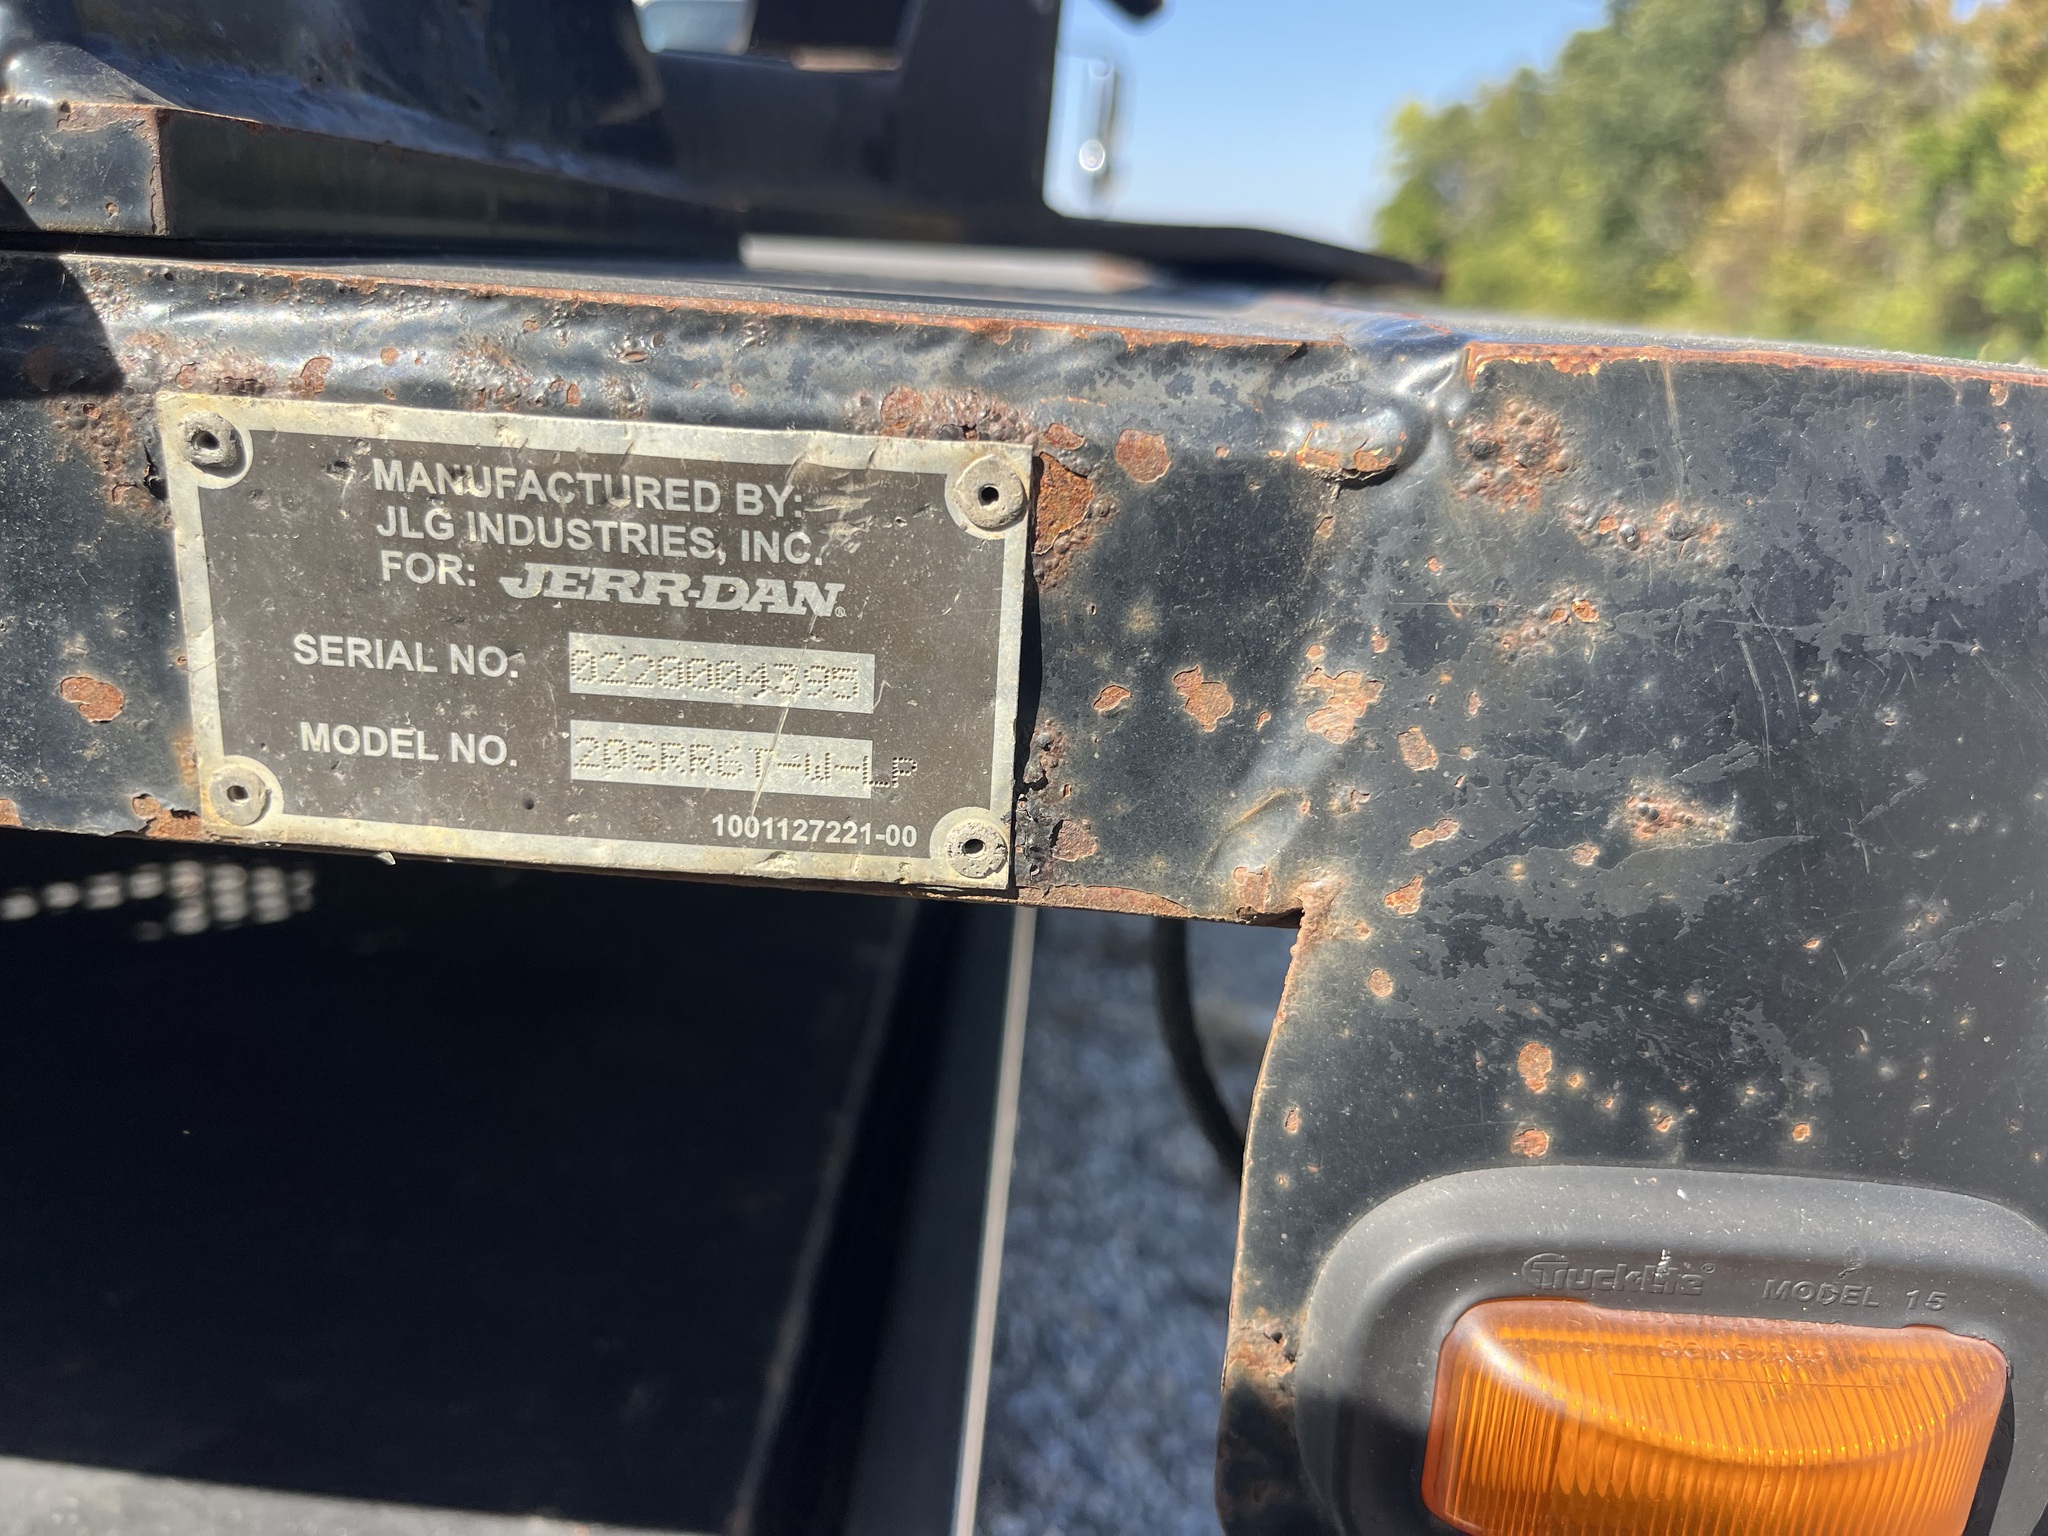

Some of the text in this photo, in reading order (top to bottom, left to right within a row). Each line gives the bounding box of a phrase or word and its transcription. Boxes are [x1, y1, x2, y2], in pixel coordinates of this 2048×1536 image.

[372, 458, 804, 517] MANUFACTURED BY:
[376, 506, 824, 566] JLG INDUSTRIES, INC.
[380, 549, 846, 618] FOR: JERR-DAN
[293, 633, 438, 673] SERIAL
[450, 643, 519, 678] NO.
[300, 721, 439, 761] MODEL
[451, 732, 518, 766] NO.
[712, 813, 917, 848] 1001127221-00
[1762, 1278, 1880, 1308] MODEL
[1905, 1289, 1947, 1312] 15
